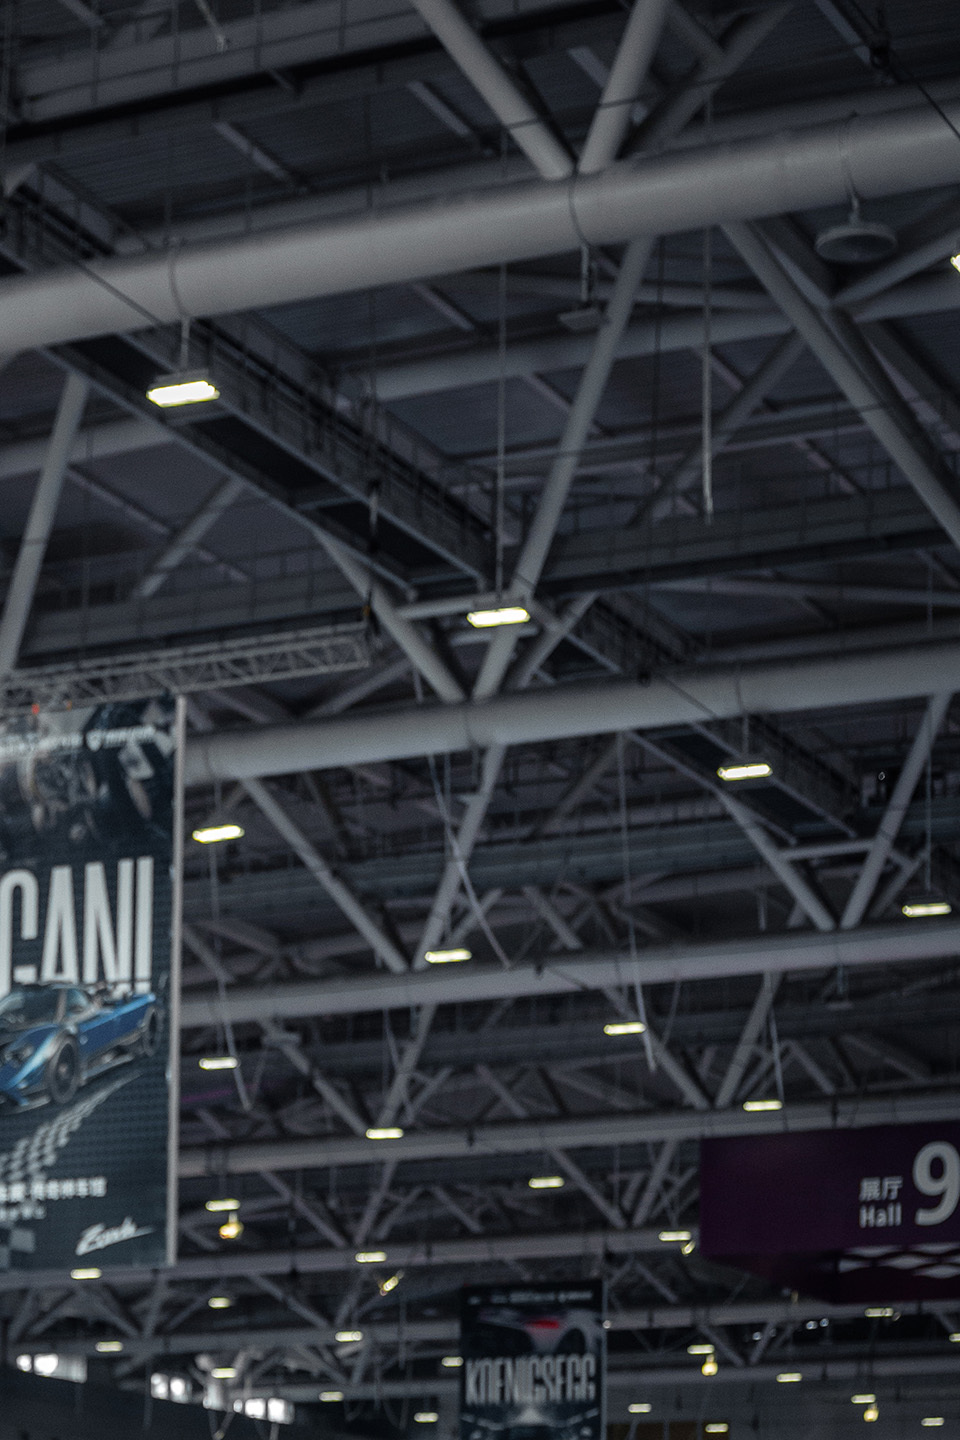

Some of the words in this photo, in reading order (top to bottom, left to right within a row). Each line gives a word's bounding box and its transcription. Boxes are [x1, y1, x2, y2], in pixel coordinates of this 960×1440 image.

[912, 1140, 960, 1226] 9
[860, 1201, 902, 1228] Hall
[465, 1354, 596, 1404] KOENIGSEGG
